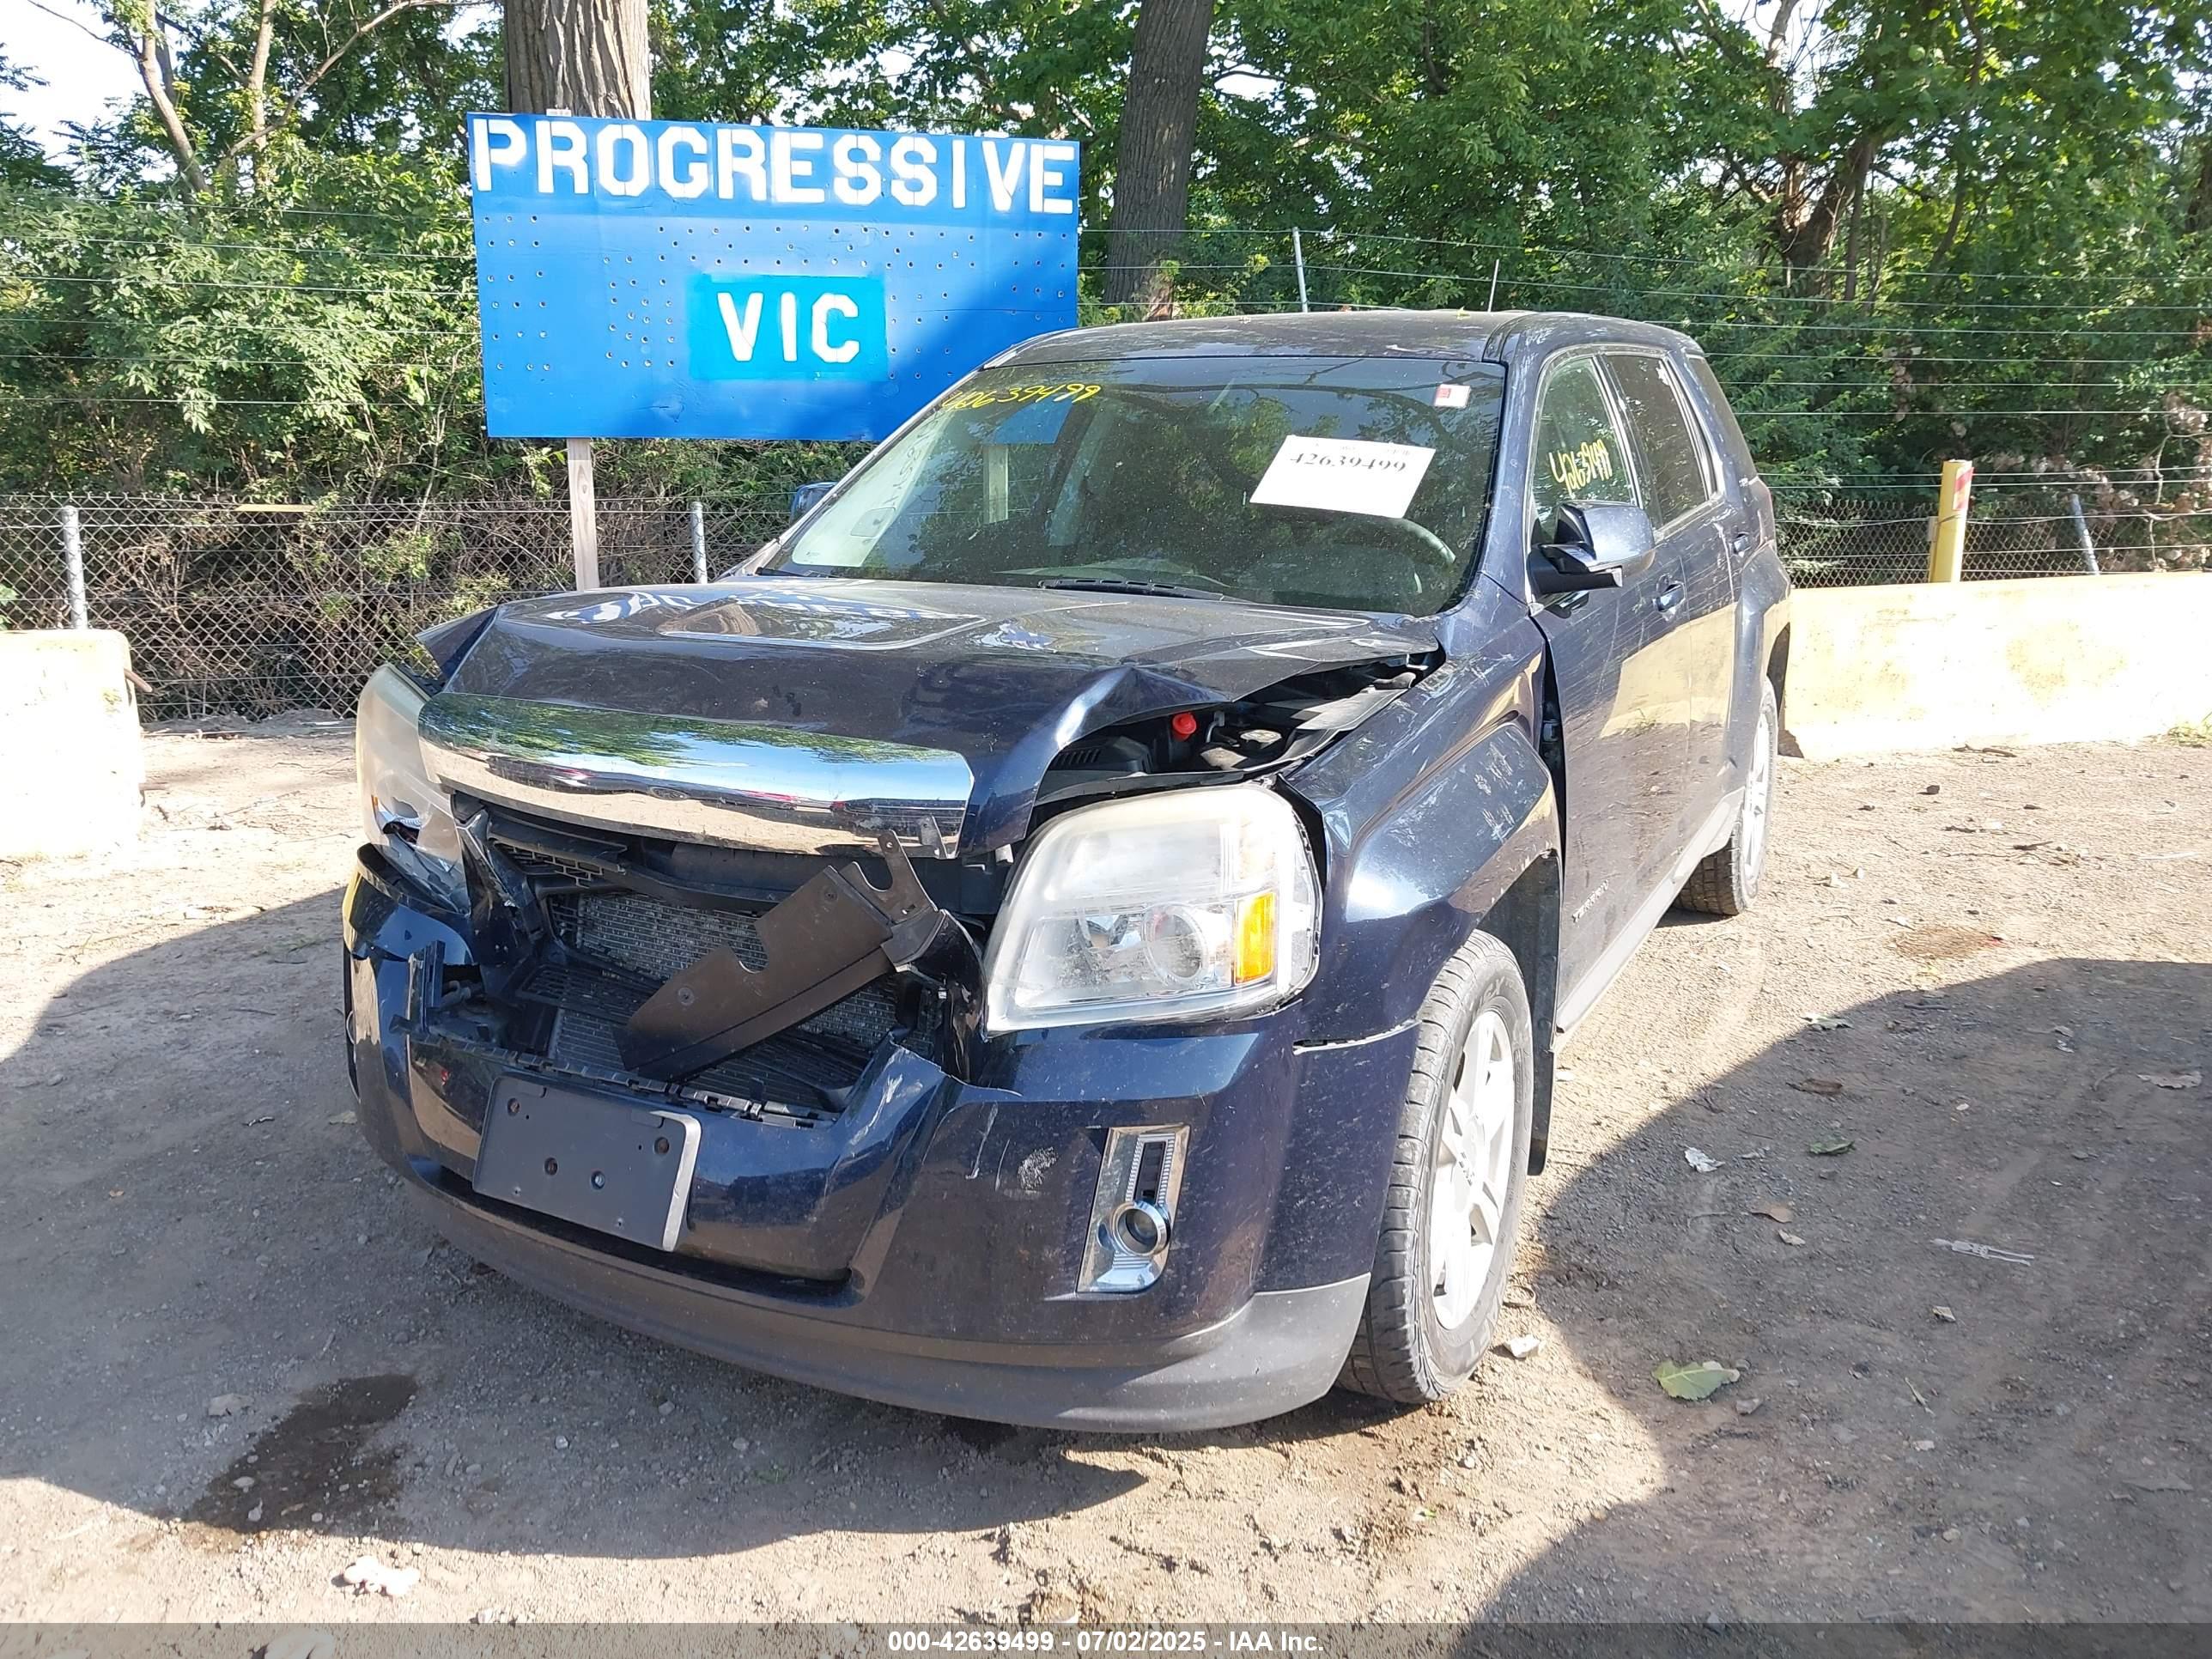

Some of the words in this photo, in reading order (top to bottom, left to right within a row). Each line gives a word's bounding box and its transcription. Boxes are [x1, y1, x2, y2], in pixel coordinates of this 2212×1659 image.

[473, 118, 1075, 213] PROGRESSIVE
[718, 293, 860, 362] VIC
[1290, 453, 1407, 472] 42639499
